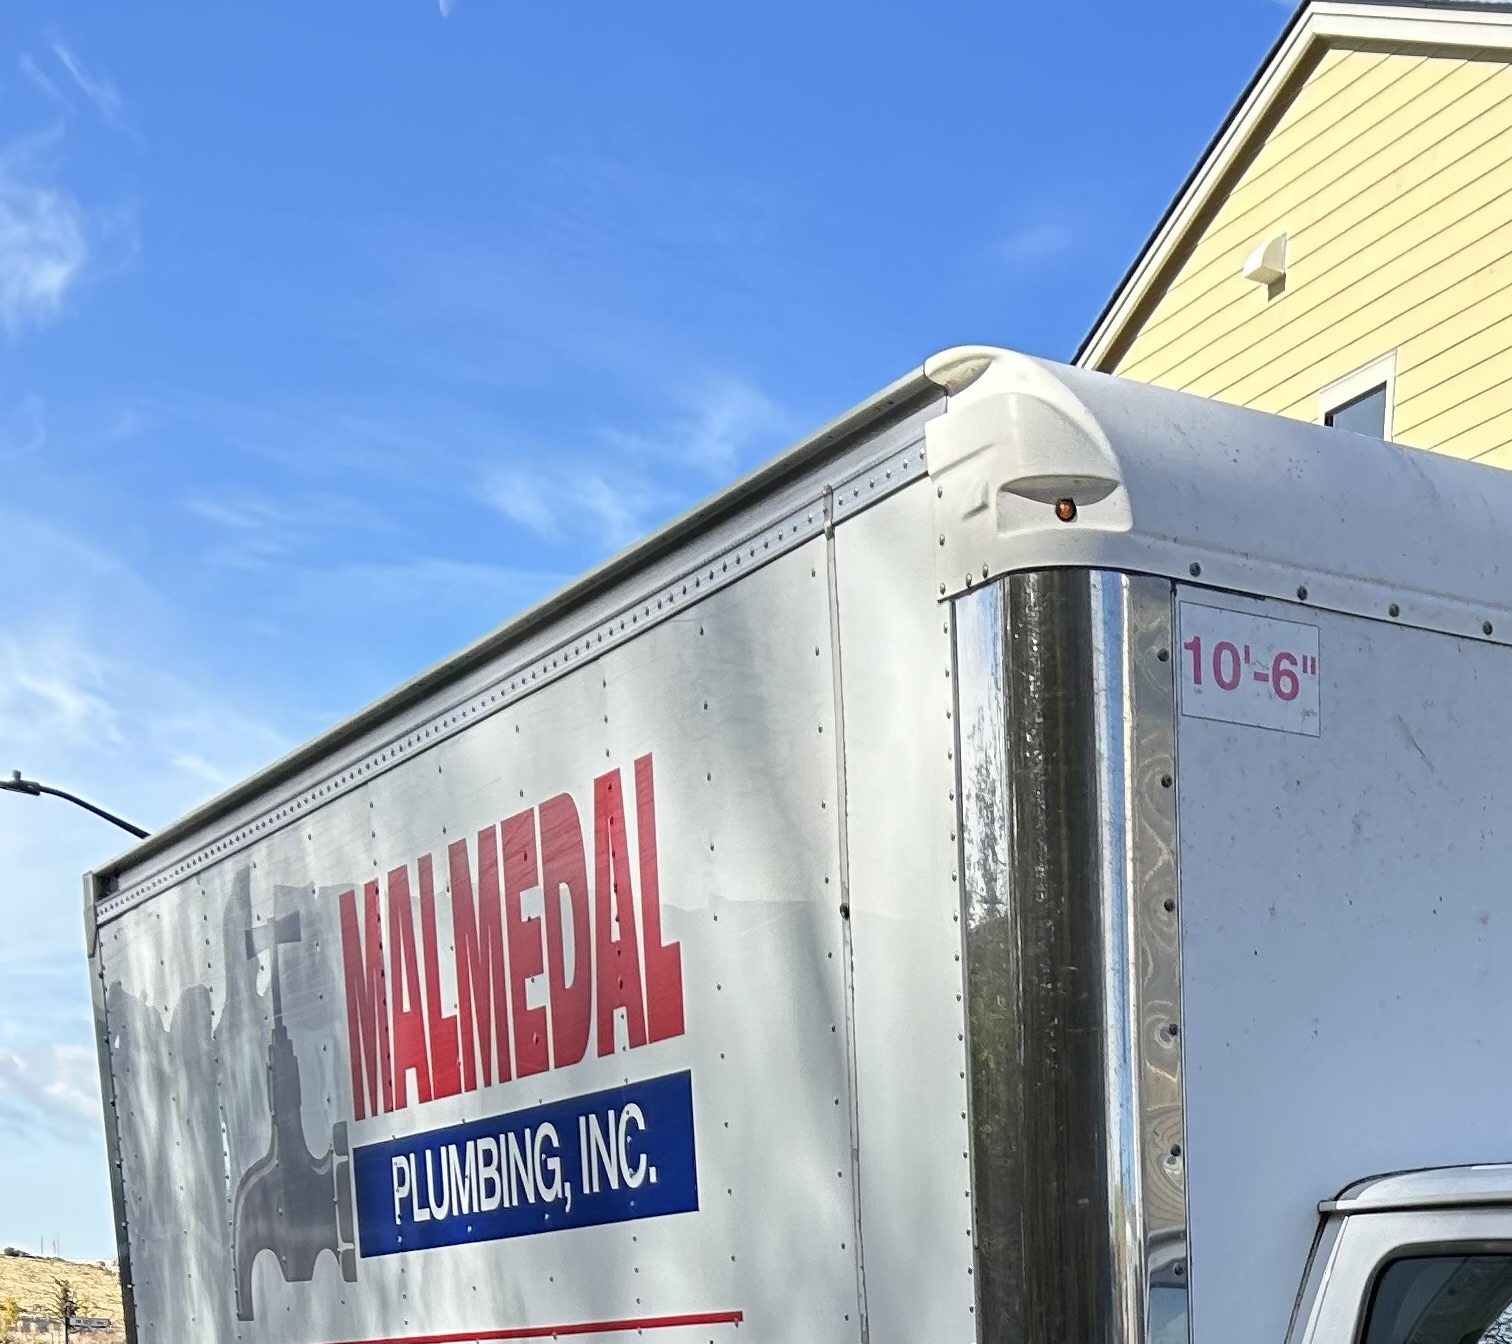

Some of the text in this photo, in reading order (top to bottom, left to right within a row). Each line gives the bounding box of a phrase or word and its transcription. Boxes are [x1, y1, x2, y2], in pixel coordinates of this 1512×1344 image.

[1184, 635, 1317, 702] 10'-6"
[338, 752, 685, 1121] MALMEDAL
[391, 1102, 657, 1225] PLUMBING, INC.
